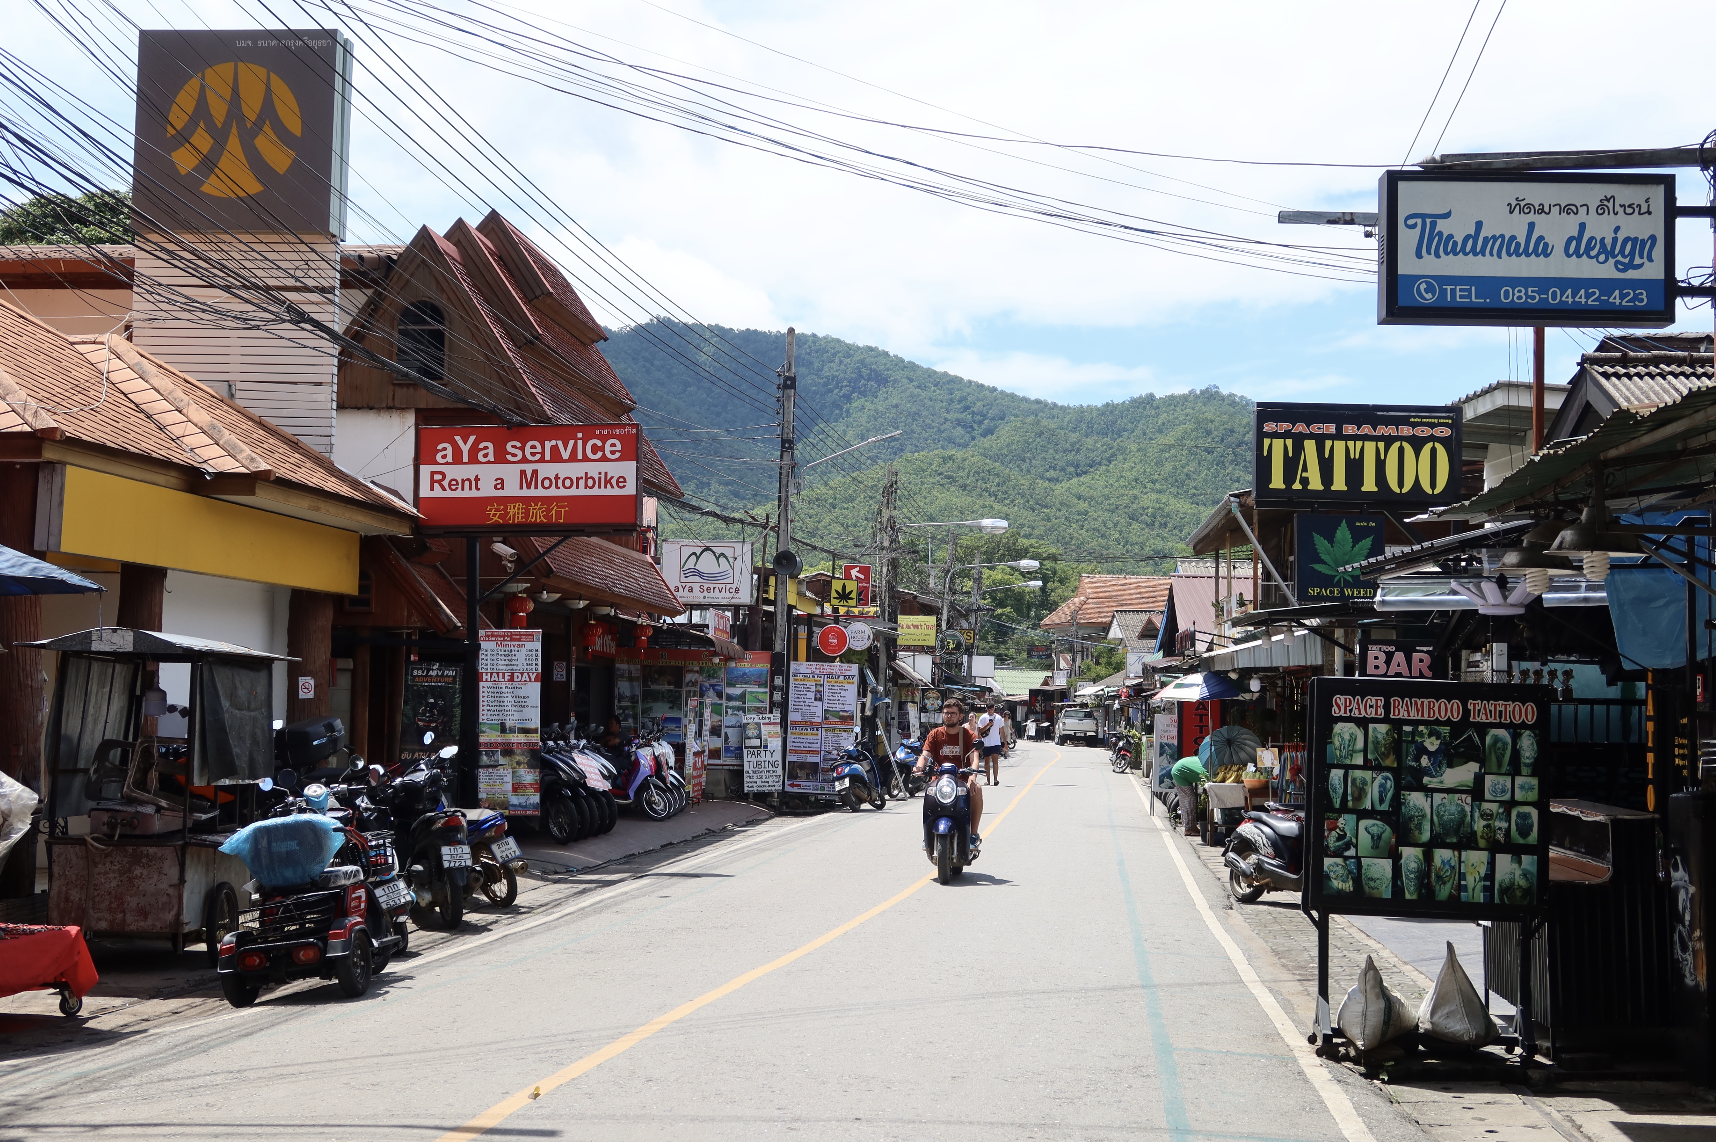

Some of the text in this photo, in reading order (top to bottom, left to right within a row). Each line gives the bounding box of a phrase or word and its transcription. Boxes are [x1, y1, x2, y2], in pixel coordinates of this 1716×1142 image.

[1507, 195, 1652, 216] ทัดมาลา ดีไซน์
[1404, 208, 1657, 273] Thadmala design
[1442, 285, 1648, 306] TEL. 085-0442-423
[1262, 422, 1452, 437] SPACE BAMBOO
[435, 432, 622, 464] aYa service
[1263, 438, 1450, 495] TATTOO
[430, 468, 628, 492] Rent a Motorbike
[486, 502, 569, 524] 安雅旅行
[674, 584, 740, 594] aYa Service
[1308, 587, 1374, 597] SPACE WEED
[660, 652, 667, 660] B
[1366, 651, 1433, 678] BAR
[483, 673, 537, 681] HALF DAY
[1332, 695, 1537, 724] SPACE BAMBOO TATTOO
[746, 750, 775, 759] PARTY
[746, 760, 780, 769] TUBING
[500, 850, 516, 861] 5417
